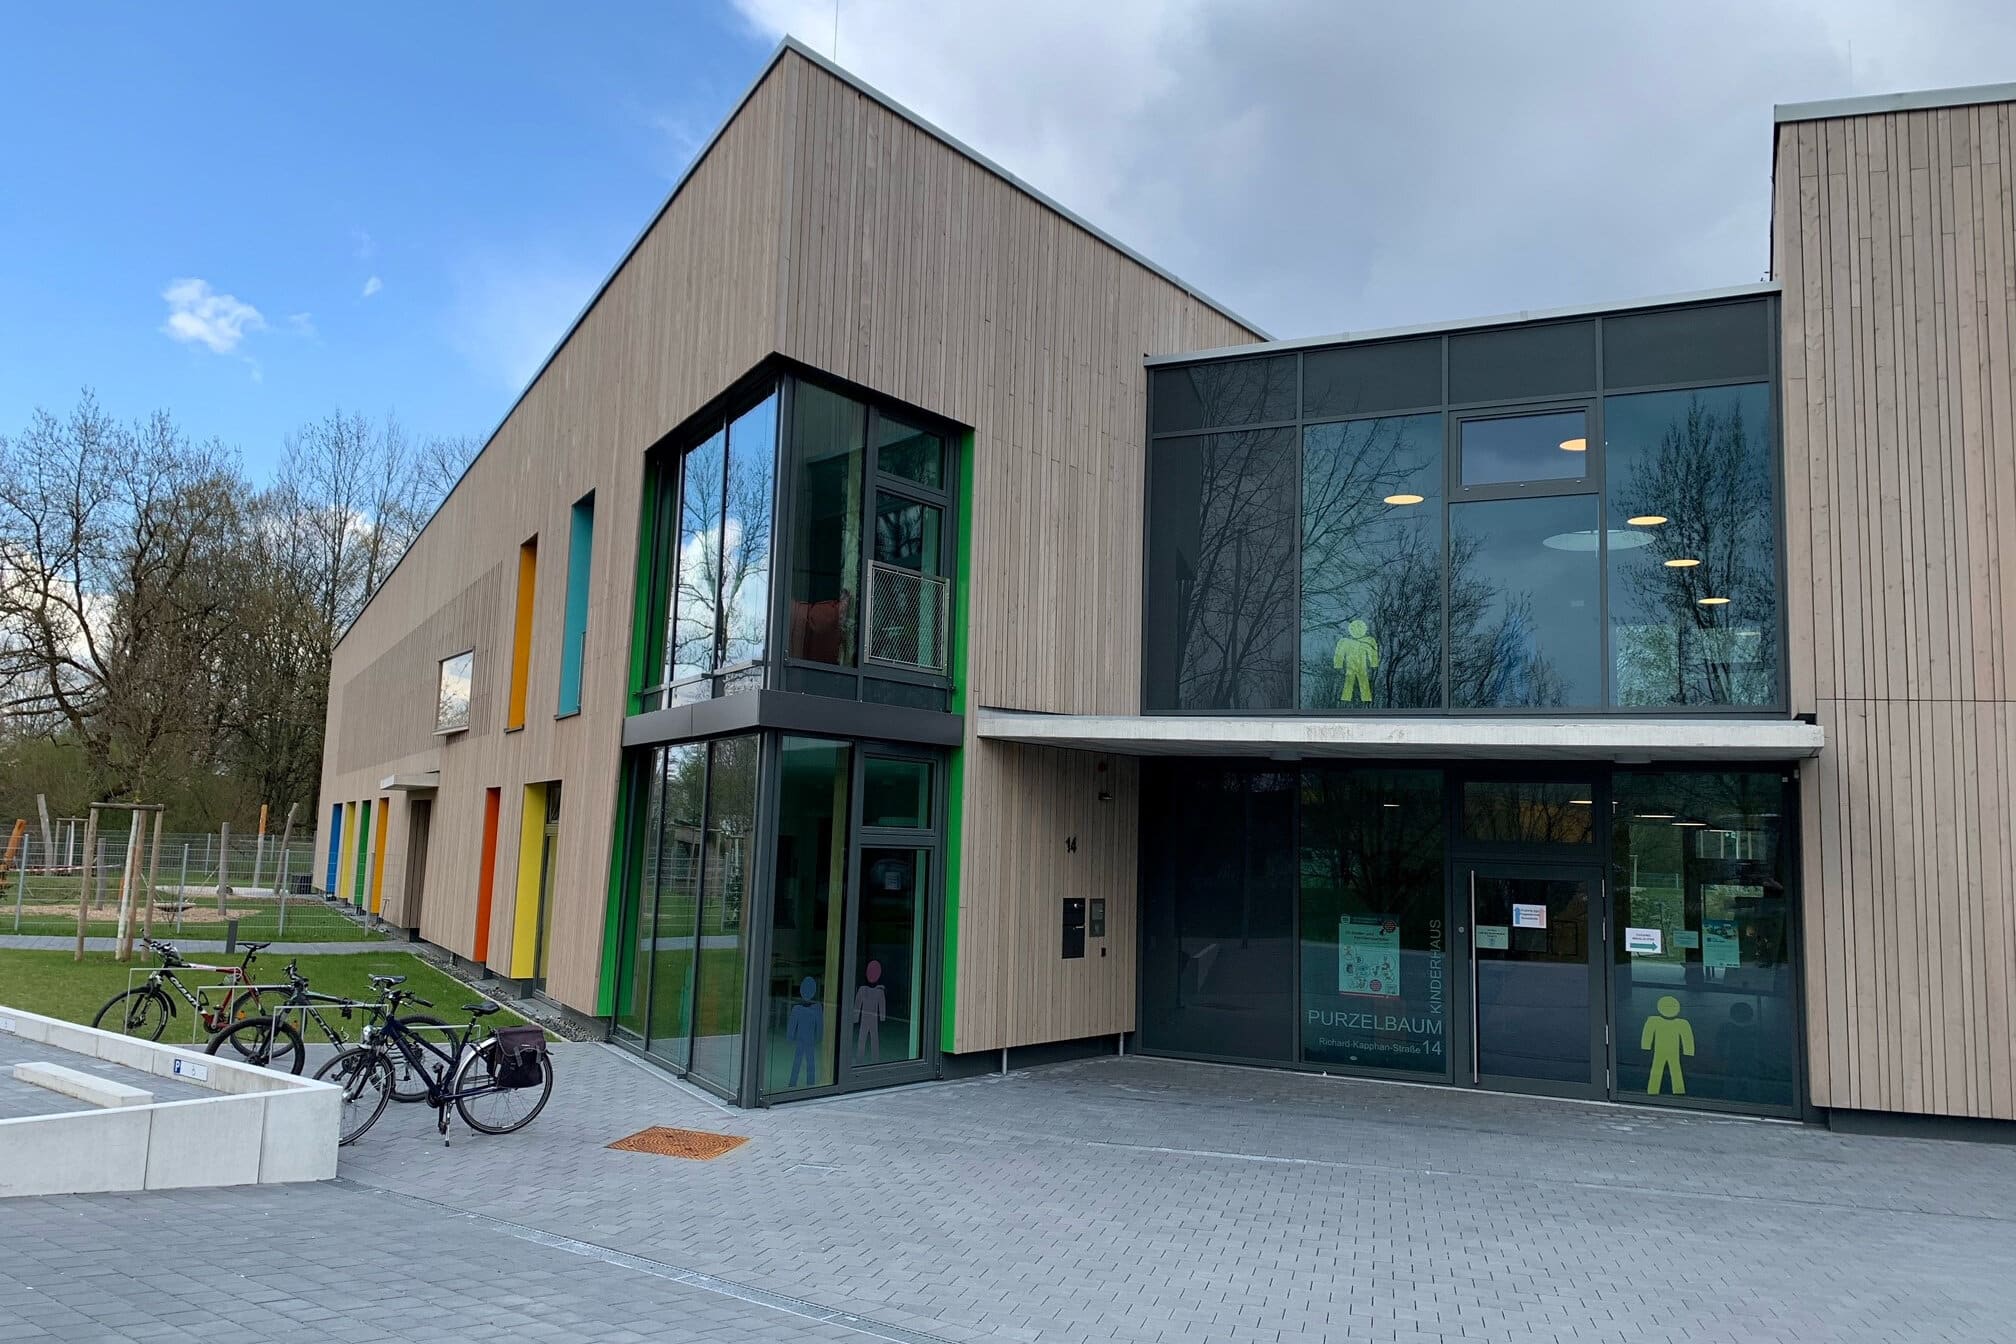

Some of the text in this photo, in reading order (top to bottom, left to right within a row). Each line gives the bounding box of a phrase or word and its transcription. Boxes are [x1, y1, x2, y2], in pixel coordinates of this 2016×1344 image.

[1065, 836, 1077, 854] 14
[1429, 919, 1442, 1015] KINDERHAUS
[1307, 1009, 1443, 1035] PURZELBAUM
[1318, 1036, 1443, 1056] Richard-Kapphan-Straße 14
